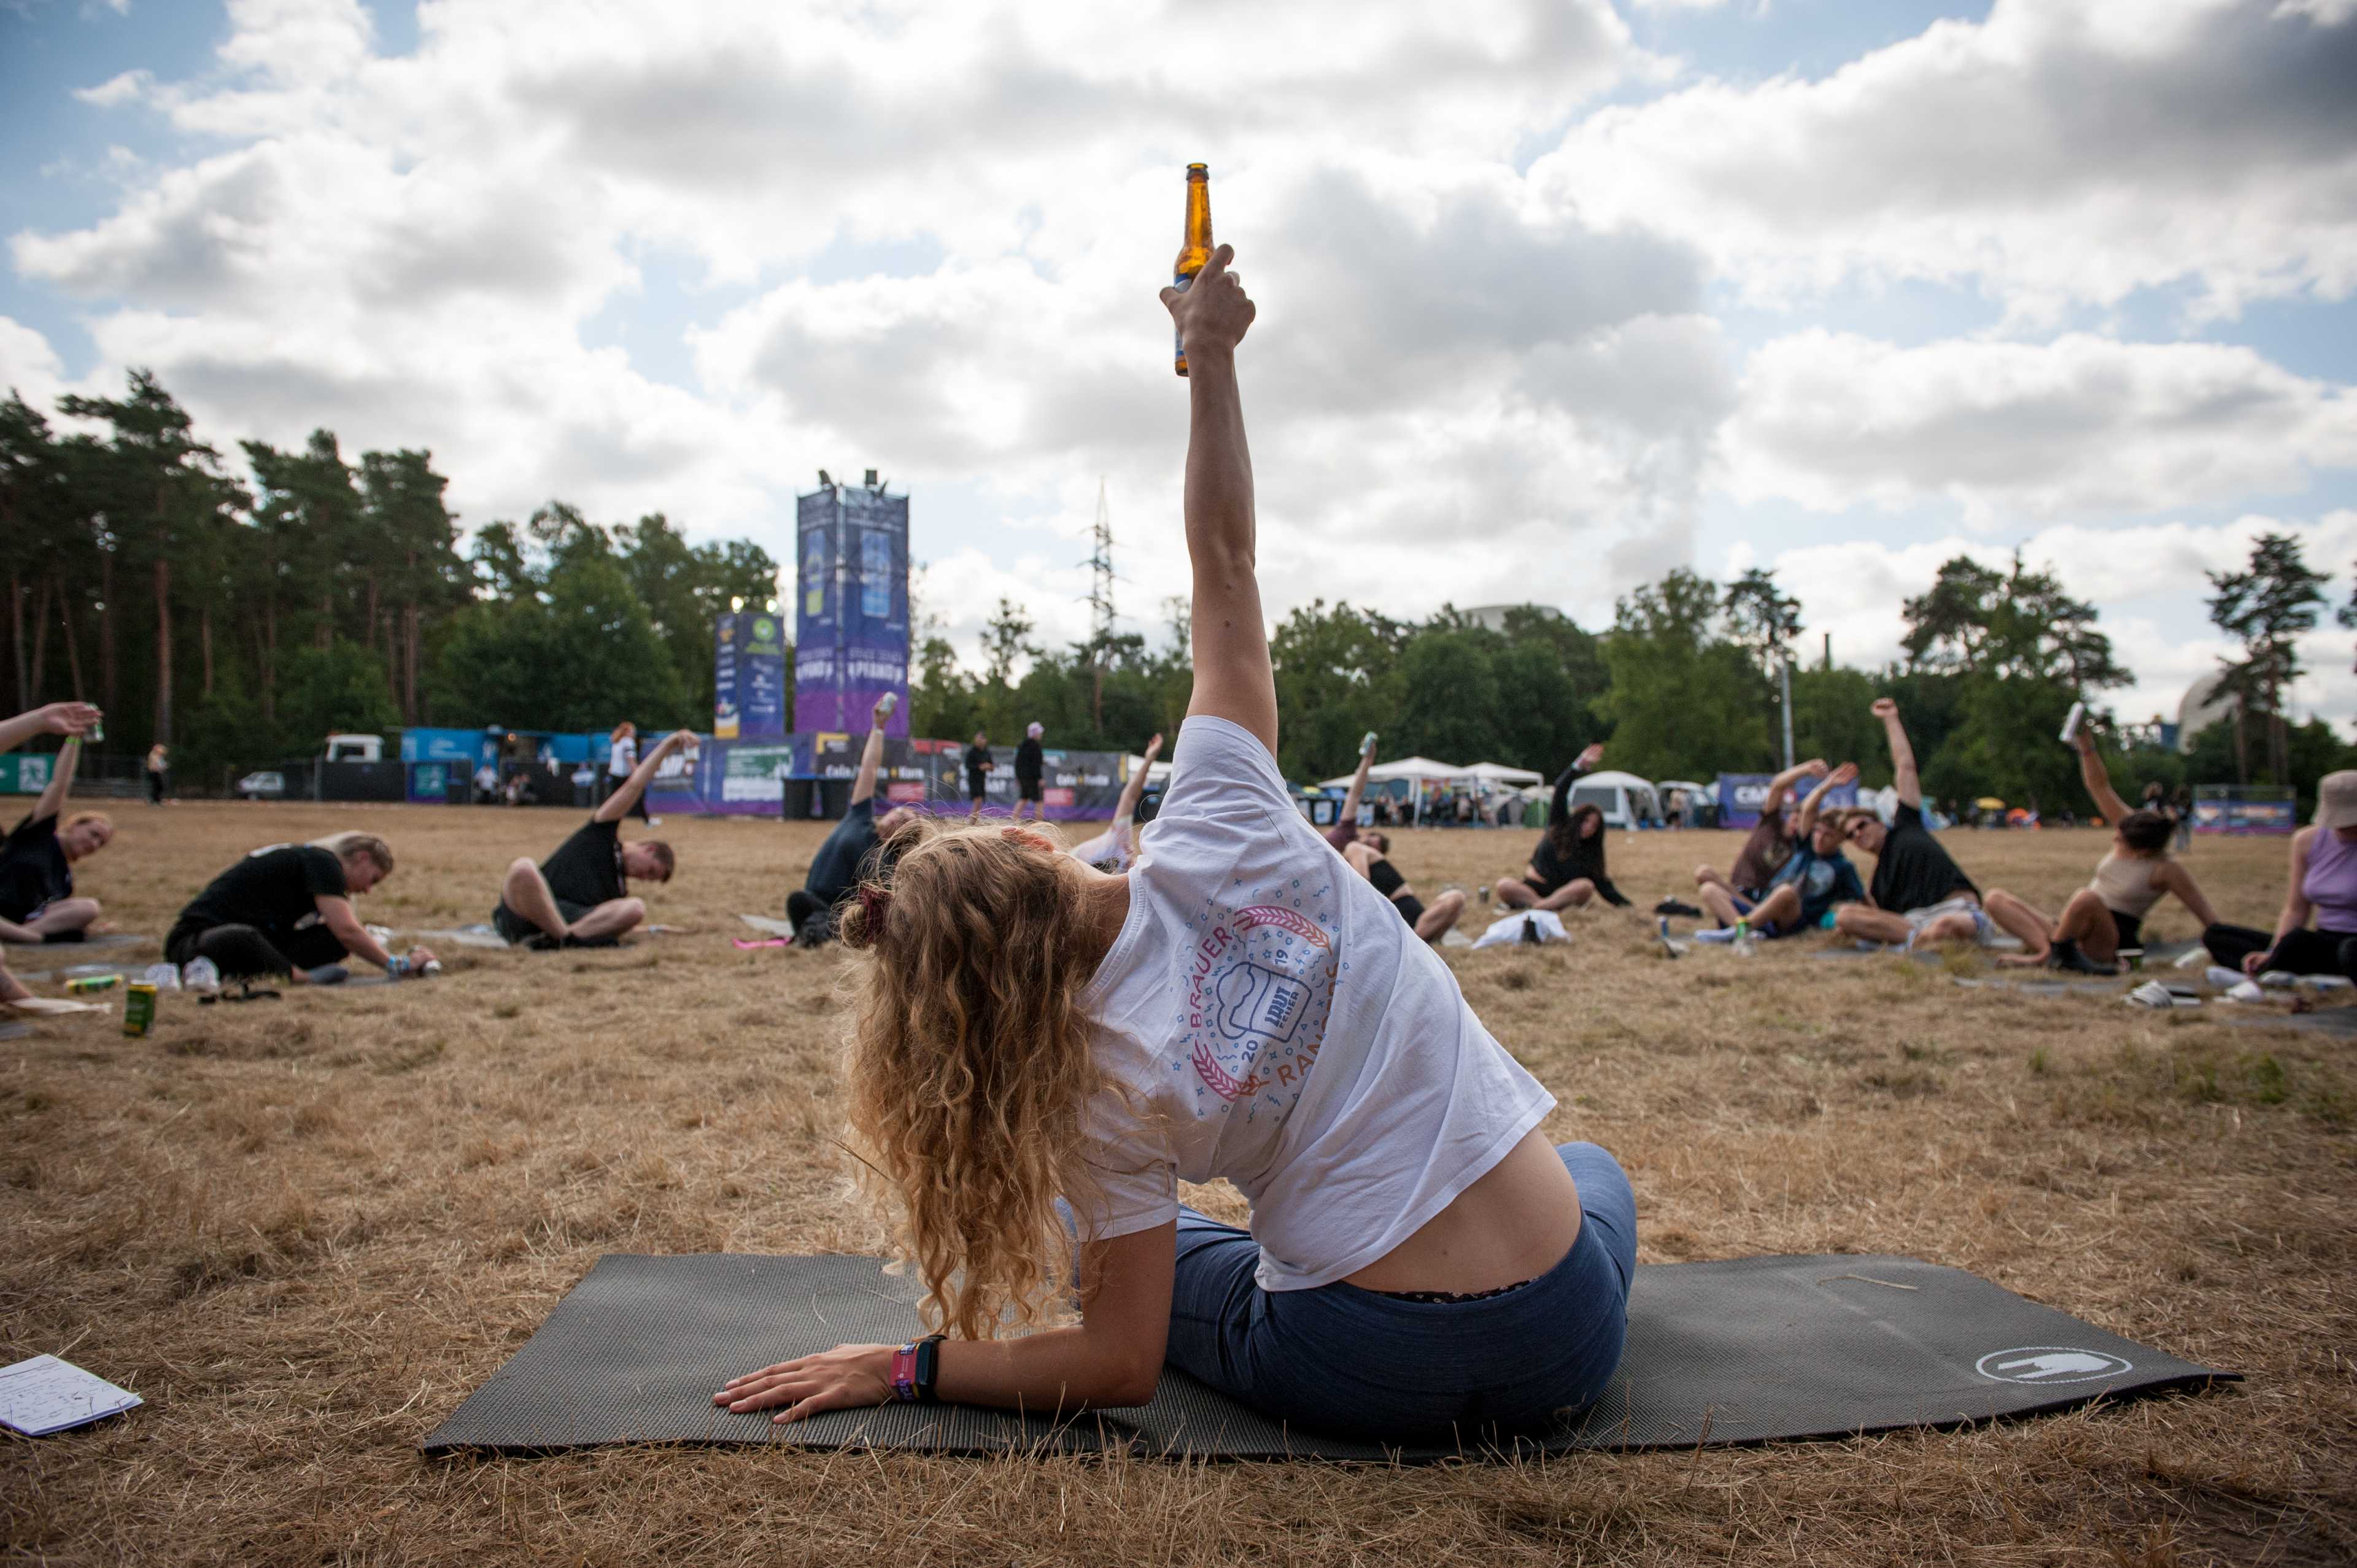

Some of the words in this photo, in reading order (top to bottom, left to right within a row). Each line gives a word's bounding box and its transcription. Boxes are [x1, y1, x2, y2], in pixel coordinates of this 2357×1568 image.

[1190, 926, 1233, 1029] BRAUER
[1242, 1040, 1258, 1063] 20
[1274, 949, 1289, 965] 19
